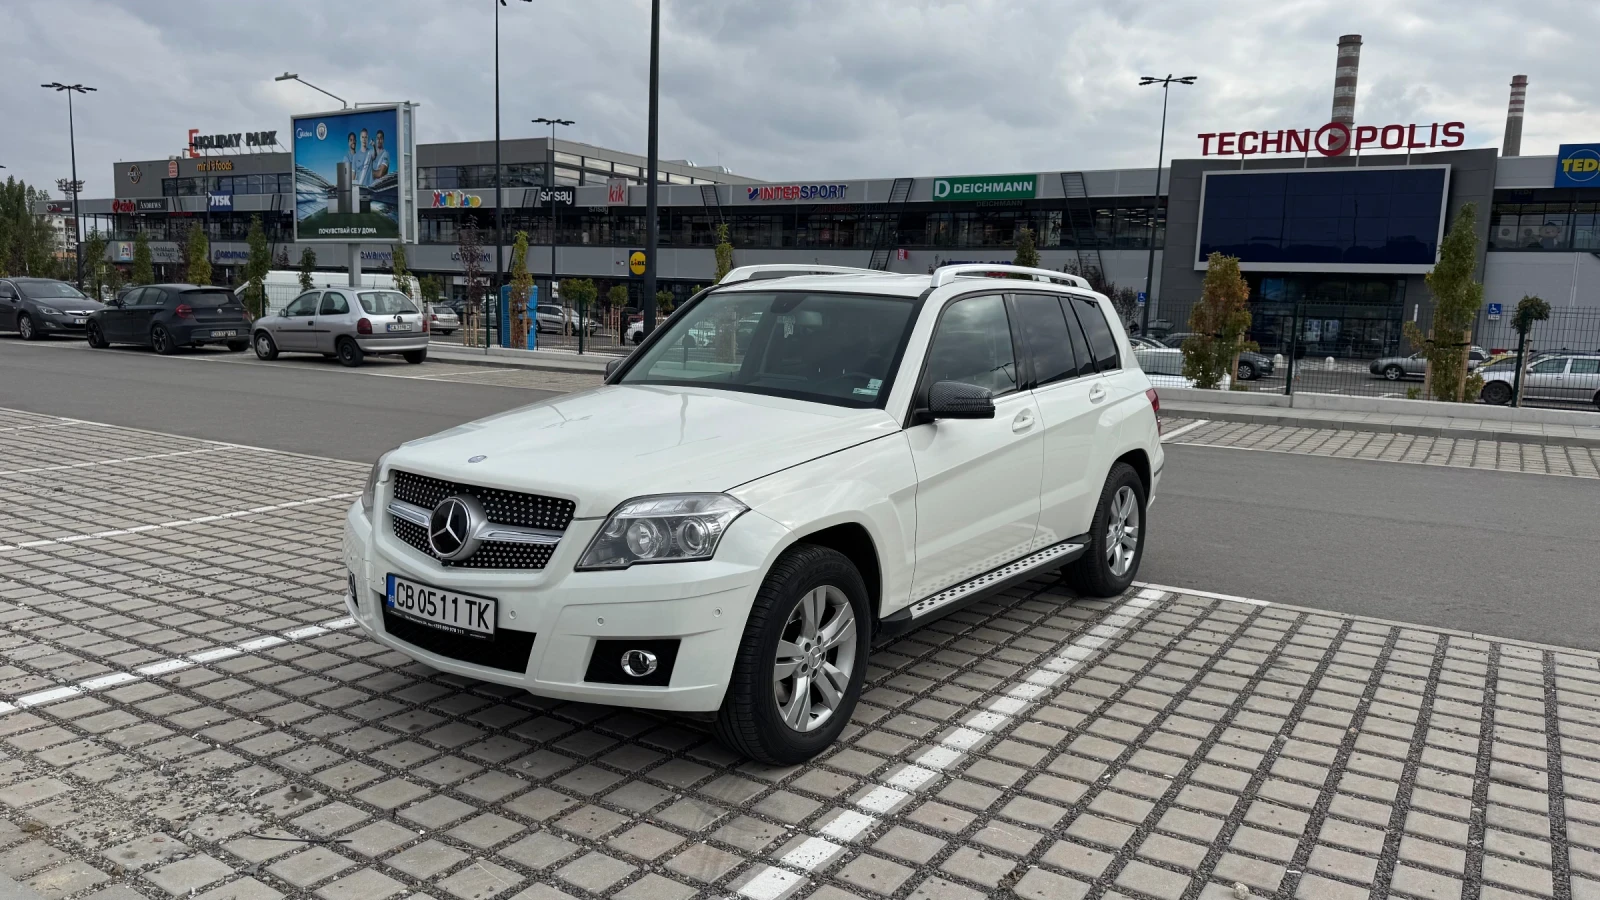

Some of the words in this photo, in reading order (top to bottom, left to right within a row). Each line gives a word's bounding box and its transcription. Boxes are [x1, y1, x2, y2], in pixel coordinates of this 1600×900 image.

[194, 133, 241, 149] HOLIDAY
[246, 131, 277, 146] PARK
[1198, 121, 1466, 157] TECHNOPOLIS
[1562, 158, 1600, 172] TED
[608, 182, 624, 202] kik
[760, 184, 848, 201] INTERSPORT
[953, 181, 1033, 194] DEICHMANN
[210, 194, 231, 207] JYSK
[976, 199, 1023, 207] DEICHMANN
[318, 226, 350, 235] ПОЧУВСТВАЙ
[361, 227, 377, 235] ДОМА
[388, 594, 395, 603] BG
[396, 582, 414, 610] CB
[418, 588, 458, 622] 0511
[465, 599, 490, 630] TK
